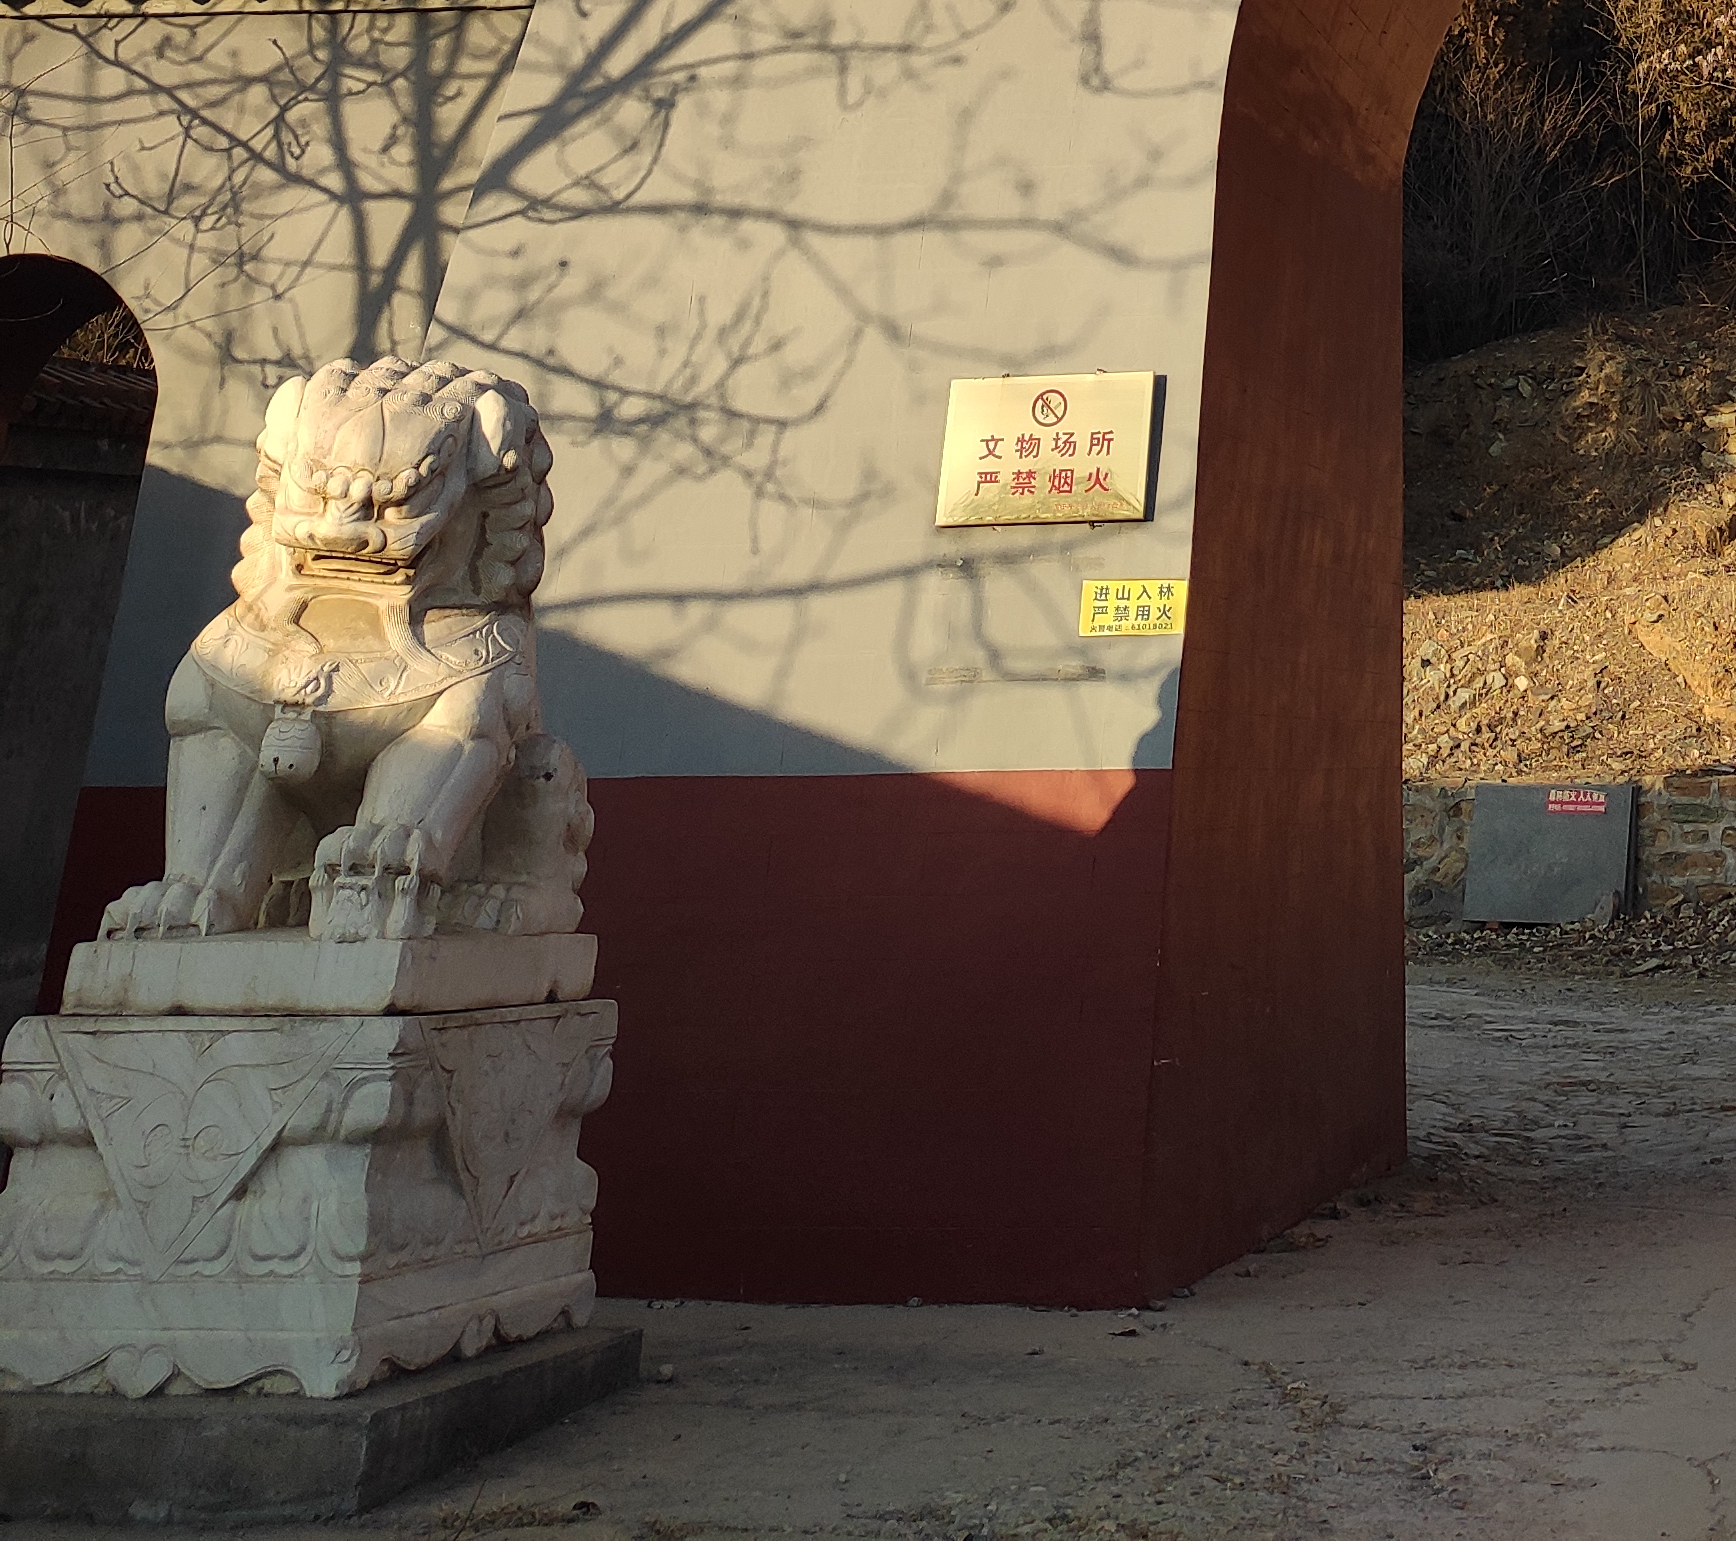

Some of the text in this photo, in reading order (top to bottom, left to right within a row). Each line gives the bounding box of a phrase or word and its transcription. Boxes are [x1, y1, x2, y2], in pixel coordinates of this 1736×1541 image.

[978, 429, 1115, 460] 文物场所
[975, 466, 1111, 497] 严禁烟火
[1093, 583, 1175, 602] 进山入林
[1091, 603, 1173, 623] 严禁用火
